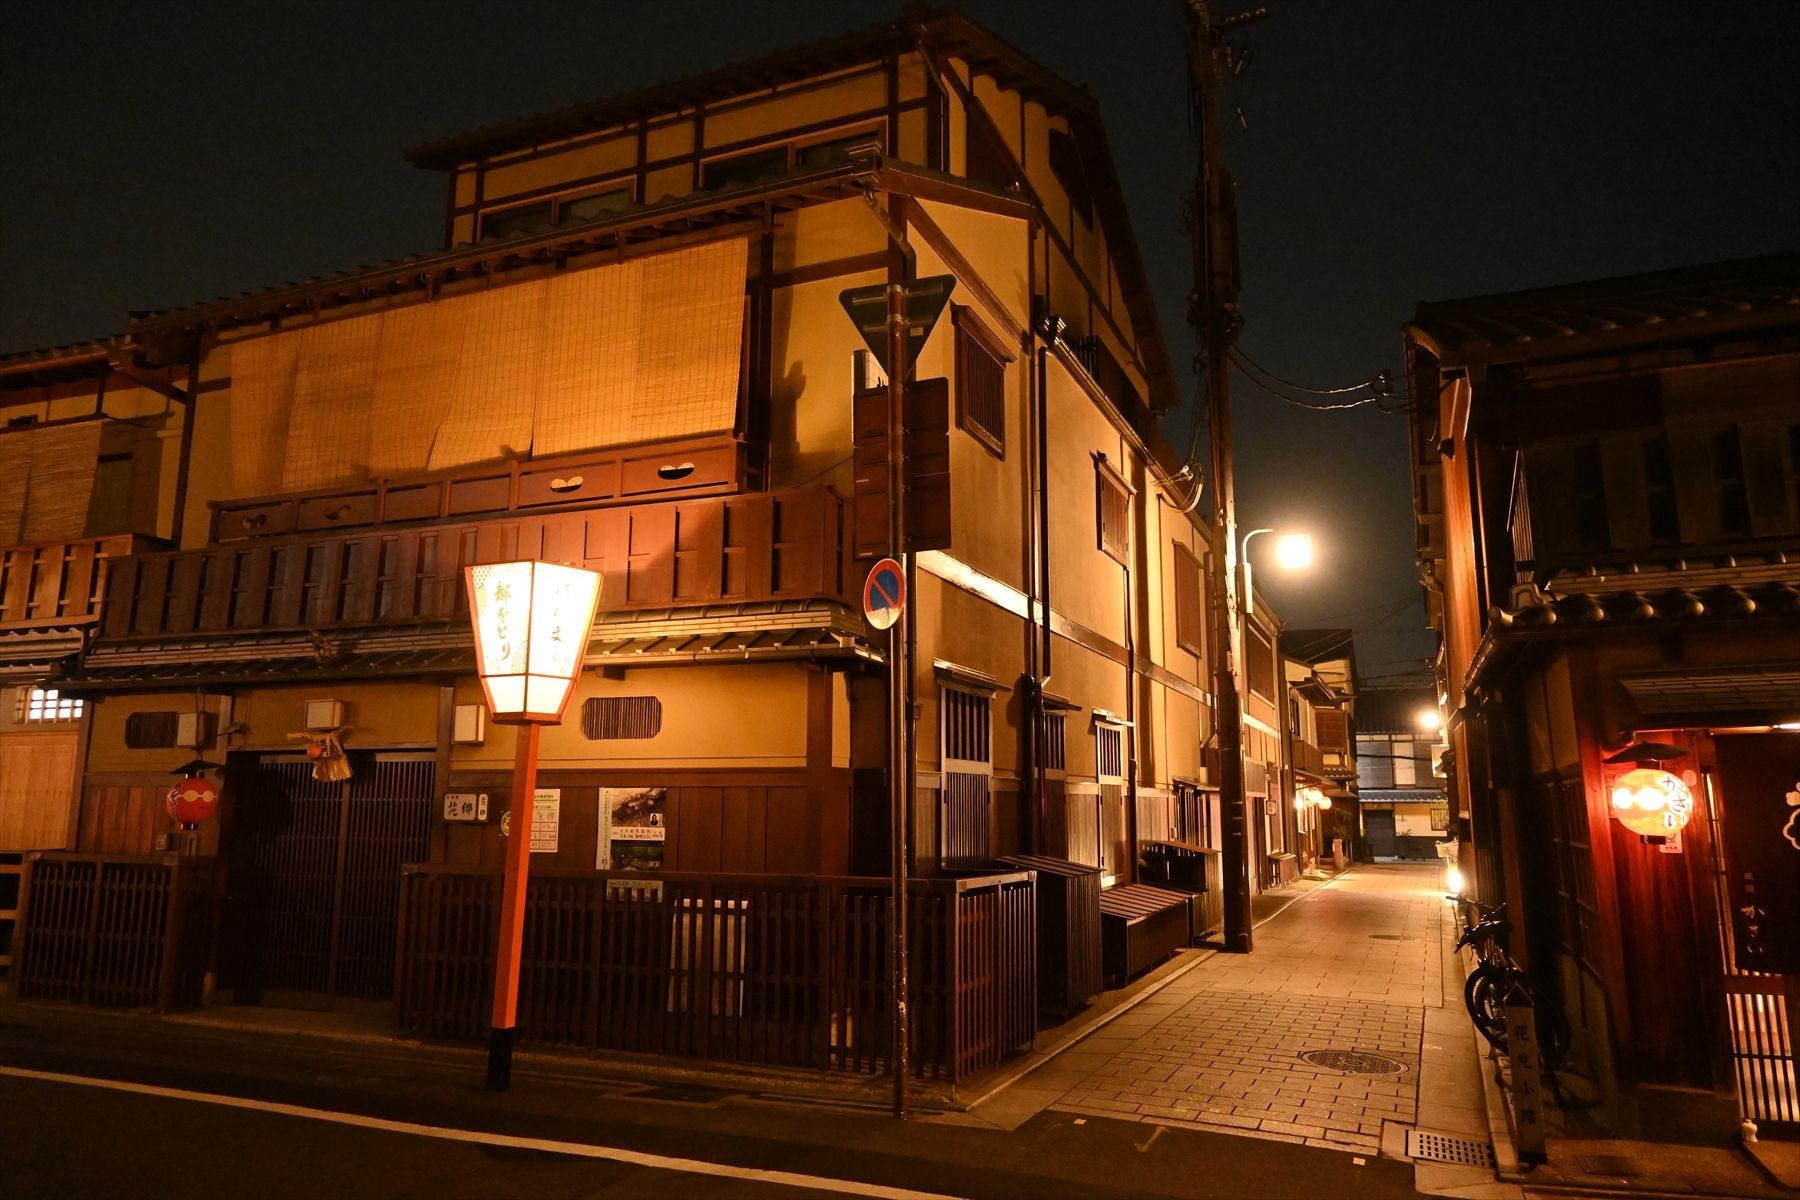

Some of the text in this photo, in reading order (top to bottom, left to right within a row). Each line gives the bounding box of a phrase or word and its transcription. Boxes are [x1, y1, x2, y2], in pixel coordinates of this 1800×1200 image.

[494, 580, 512, 661] 都をどり
[1662, 776, 1687, 827] かさい
[1740, 905, 1765, 954] かさい
[1514, 1024, 1537, 1124] 花見小路
